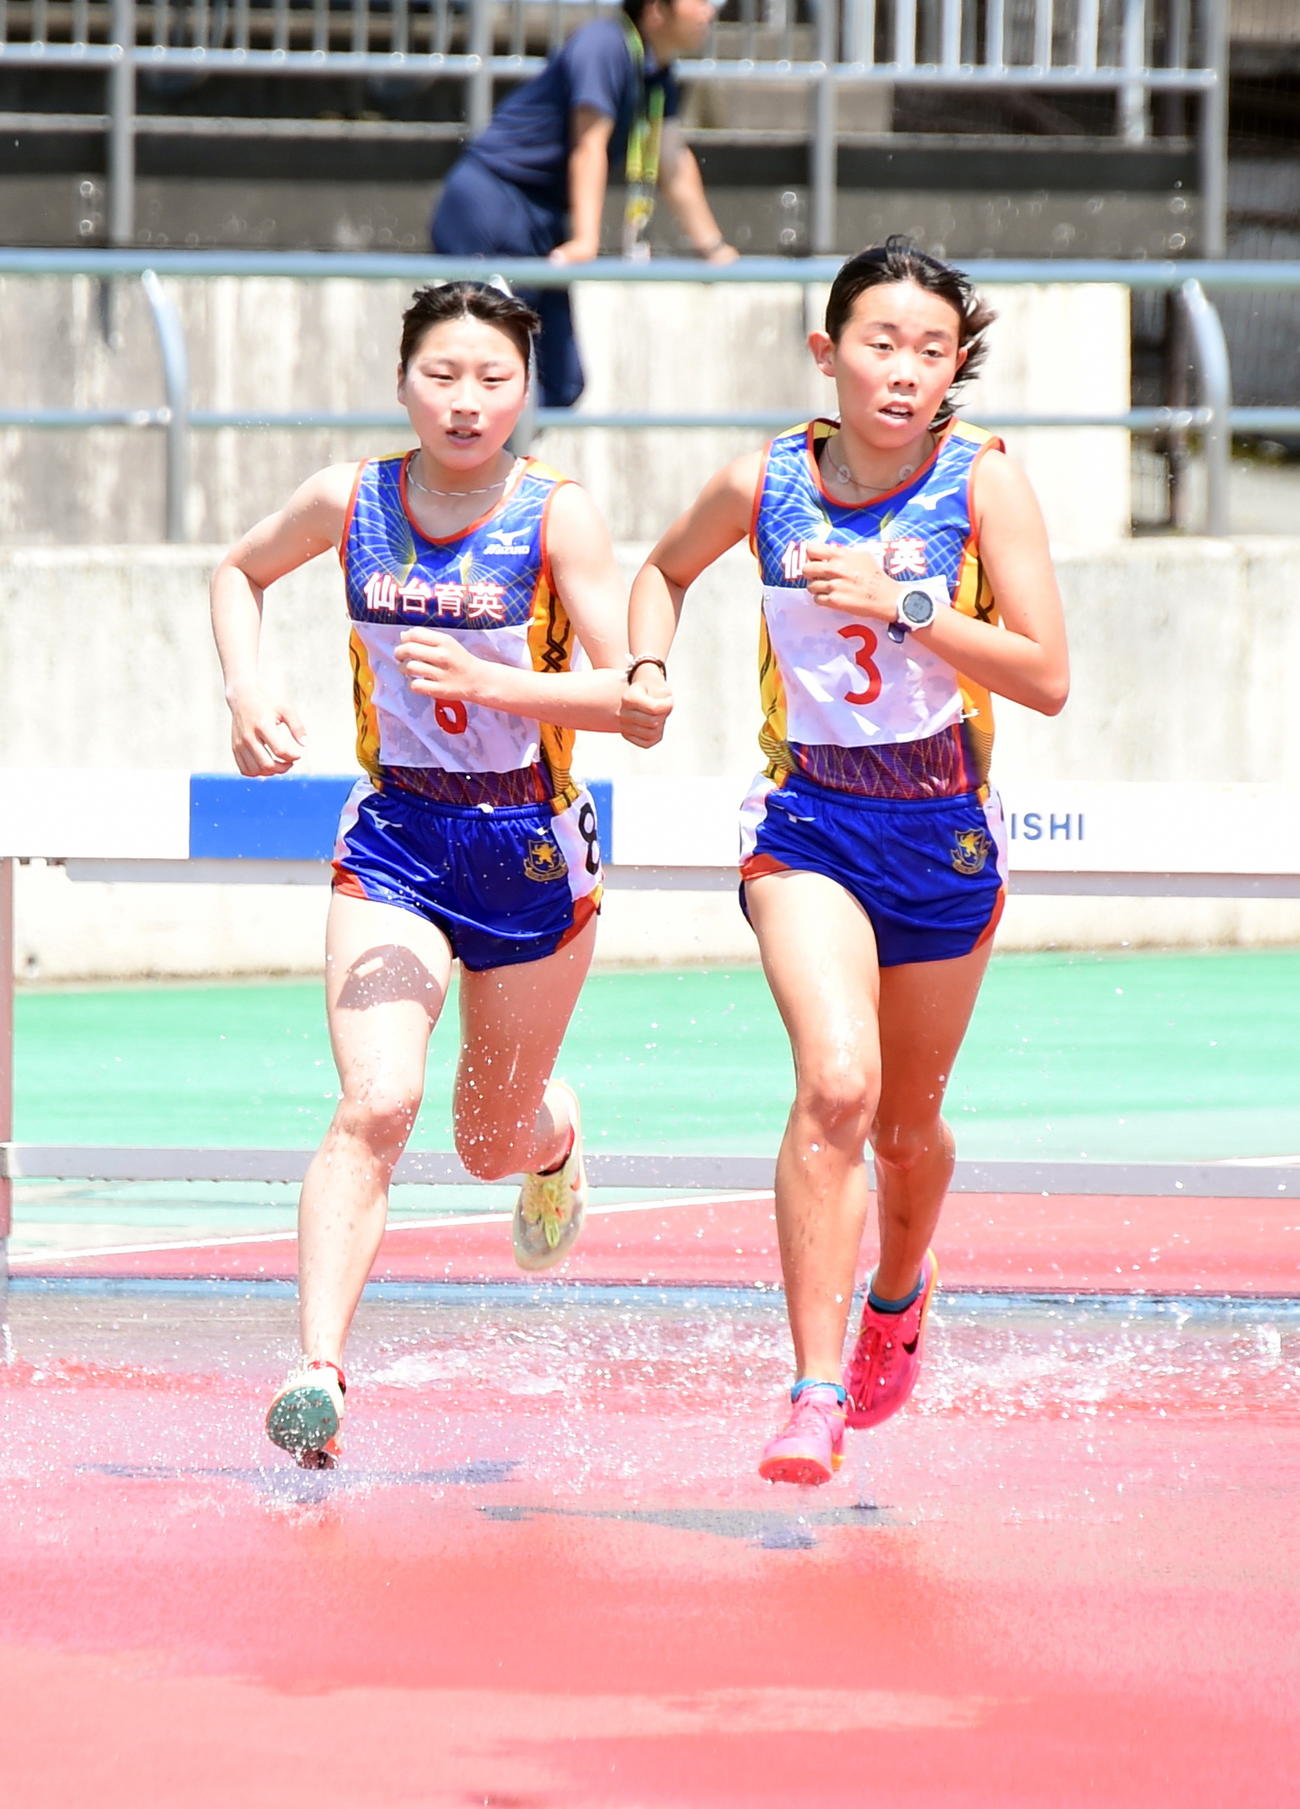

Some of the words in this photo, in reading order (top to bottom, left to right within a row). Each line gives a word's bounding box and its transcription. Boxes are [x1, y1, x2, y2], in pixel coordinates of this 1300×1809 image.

[363, 570, 506, 620] 仙台育英
[838, 624, 882, 705] 3
[578, 802, 599, 875] 8
